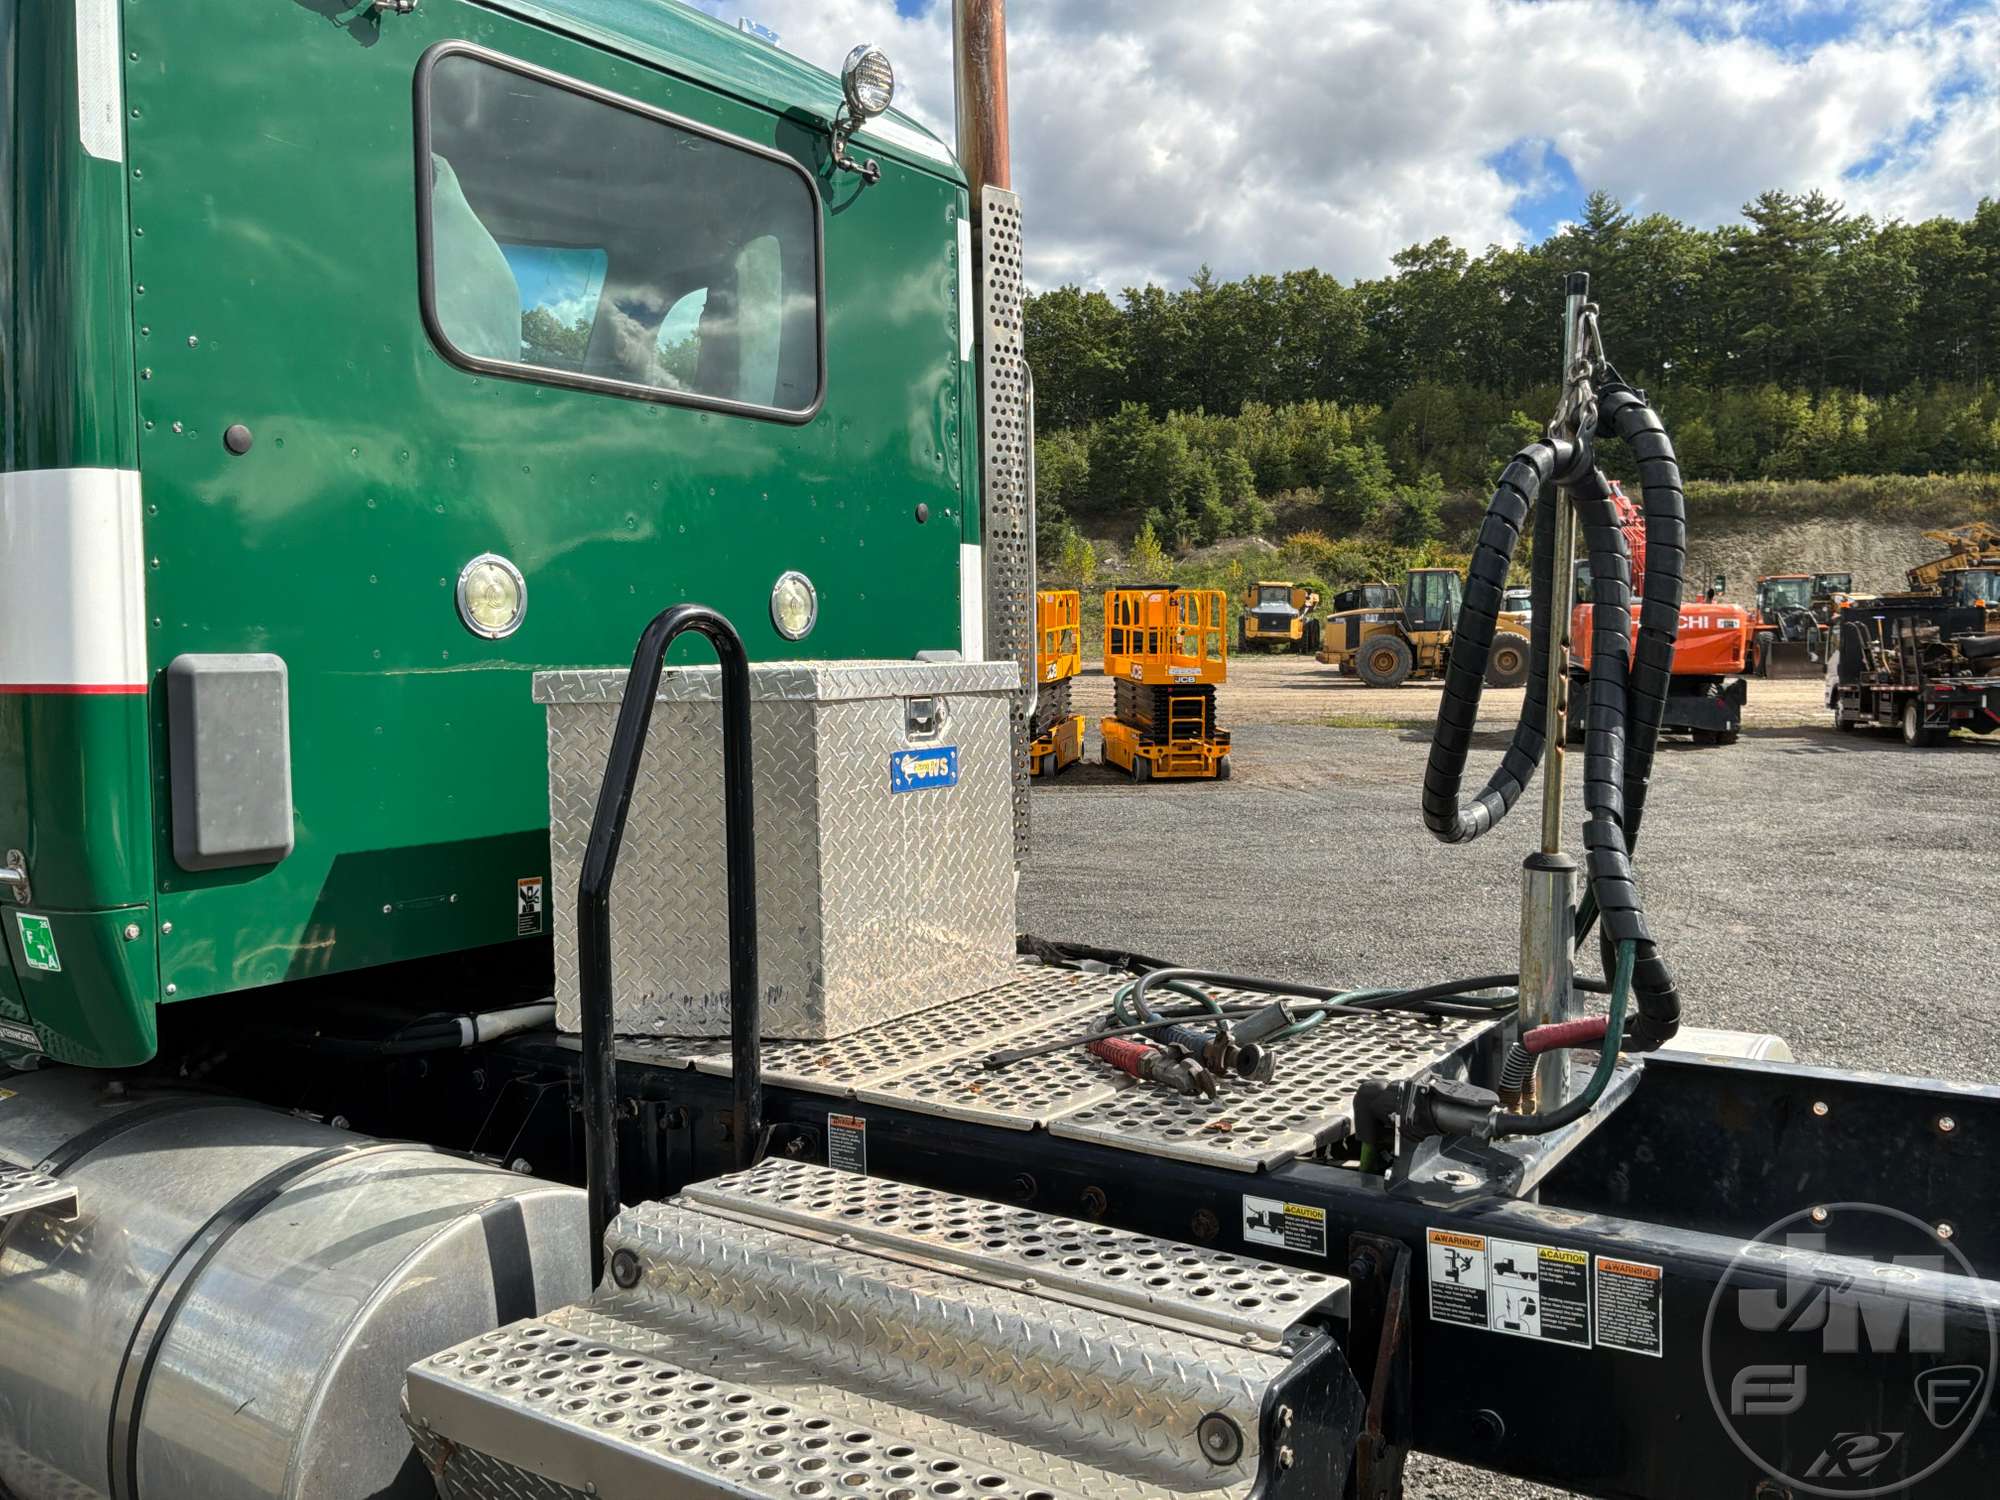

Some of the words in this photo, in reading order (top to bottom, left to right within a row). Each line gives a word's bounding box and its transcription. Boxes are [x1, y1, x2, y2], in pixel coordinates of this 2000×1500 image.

[1130, 664, 1143, 680] JCB
[1291, 1206, 1324, 1219] CAUTION
[1439, 1234, 1481, 1248] WARNING
[1547, 1251, 1585, 1263] CAUTION
[1611, 1263, 1652, 1277] WARNING
